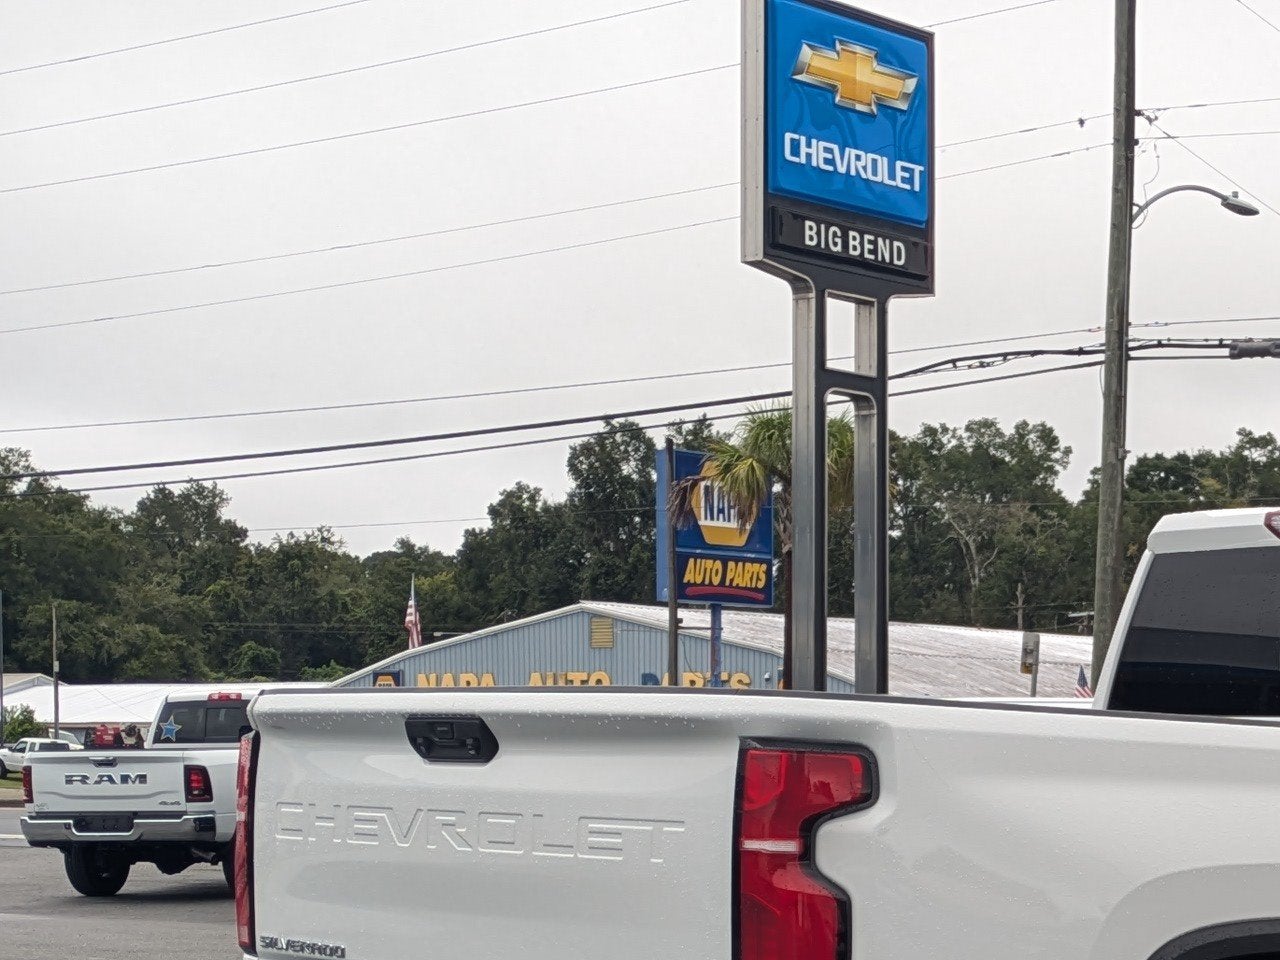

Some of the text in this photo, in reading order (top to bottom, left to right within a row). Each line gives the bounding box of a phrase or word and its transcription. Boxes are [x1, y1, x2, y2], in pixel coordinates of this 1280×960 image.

[784, 132, 924, 192] CHEVROLET
[804, 220, 906, 266] BIG BEND
[683, 558, 767, 589] AUTO PARTS
[64, 773, 147, 785] RAM
[275, 802, 686, 863] CHEVROLET
[260, 936, 346, 959] SILVERADO
